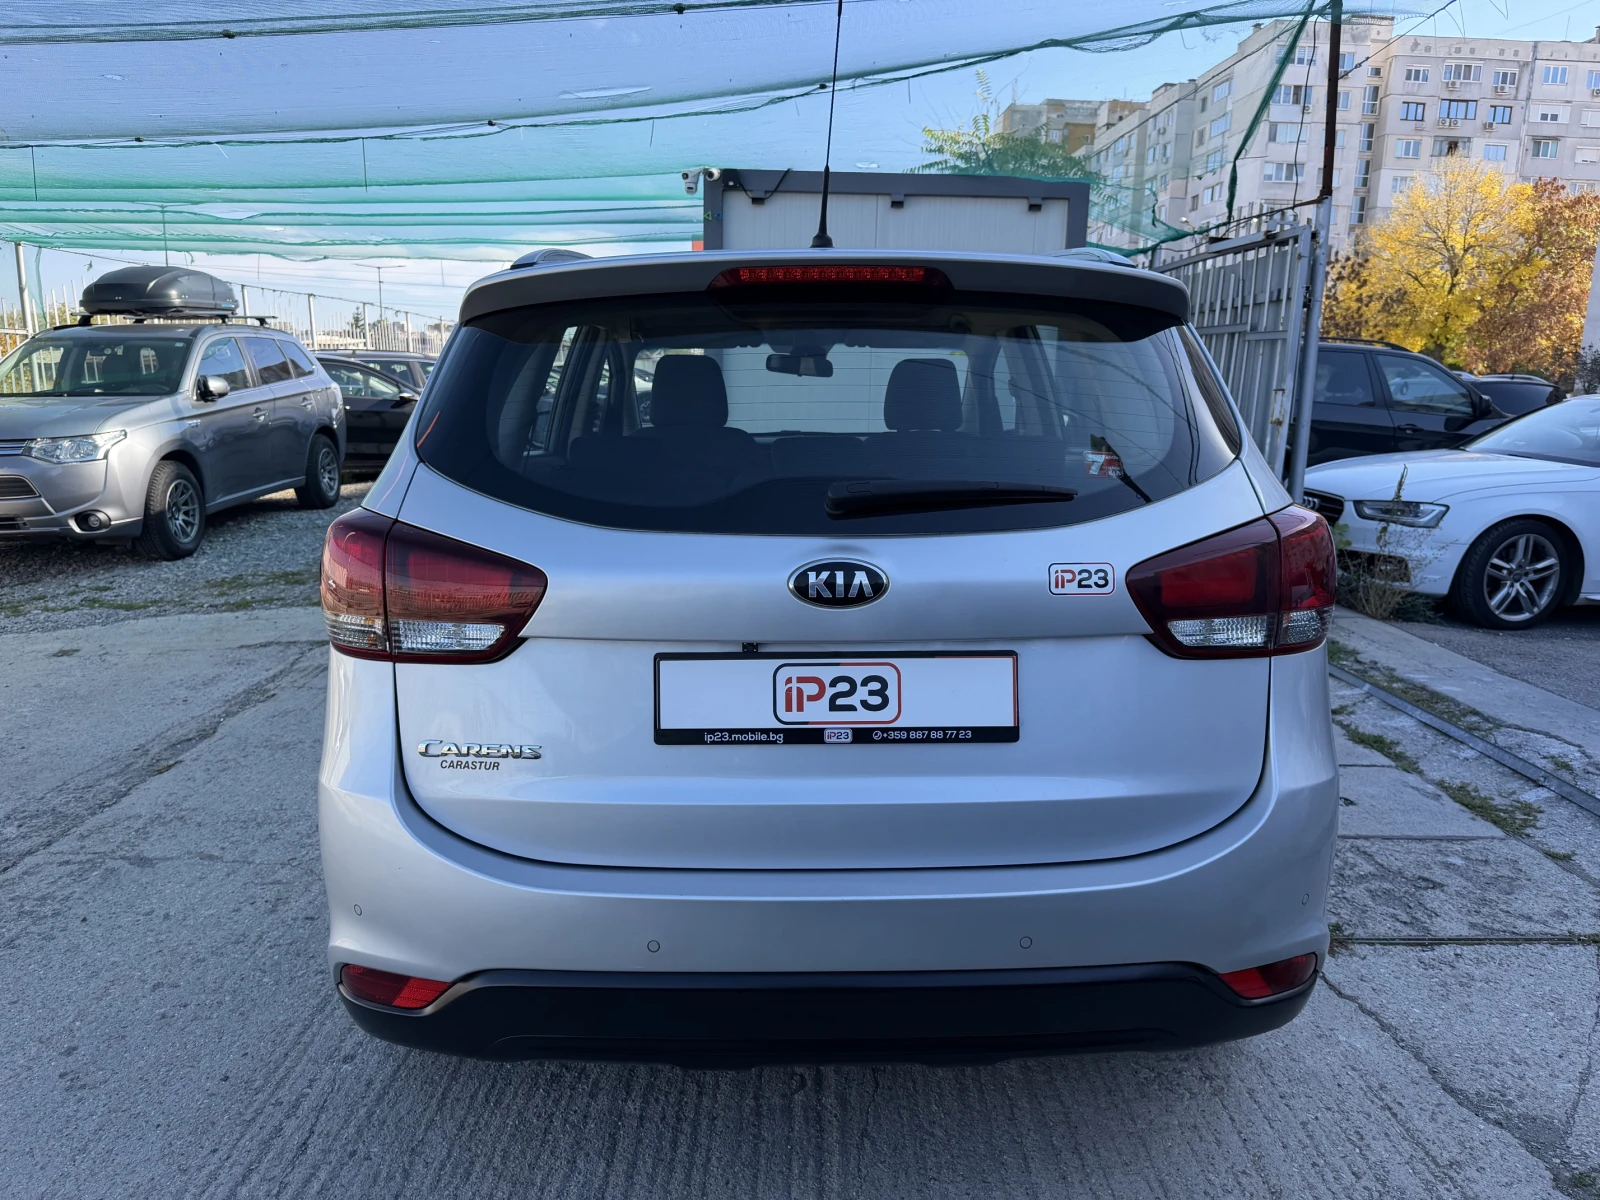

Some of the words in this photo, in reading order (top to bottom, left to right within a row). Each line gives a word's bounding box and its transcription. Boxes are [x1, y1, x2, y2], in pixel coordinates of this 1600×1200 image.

[807, 571, 873, 598] KIA
[704, 732, 784, 744] ip23.mobile.bg
[883, 731, 907, 739] +359
[909, 731, 928, 739] 887
[930, 731, 944, 739] 88
[945, 731, 957, 739] 77
[959, 731, 972, 739] 23
[418, 739, 542, 759] CARENS
[440, 760, 500, 770] CARASTUR
